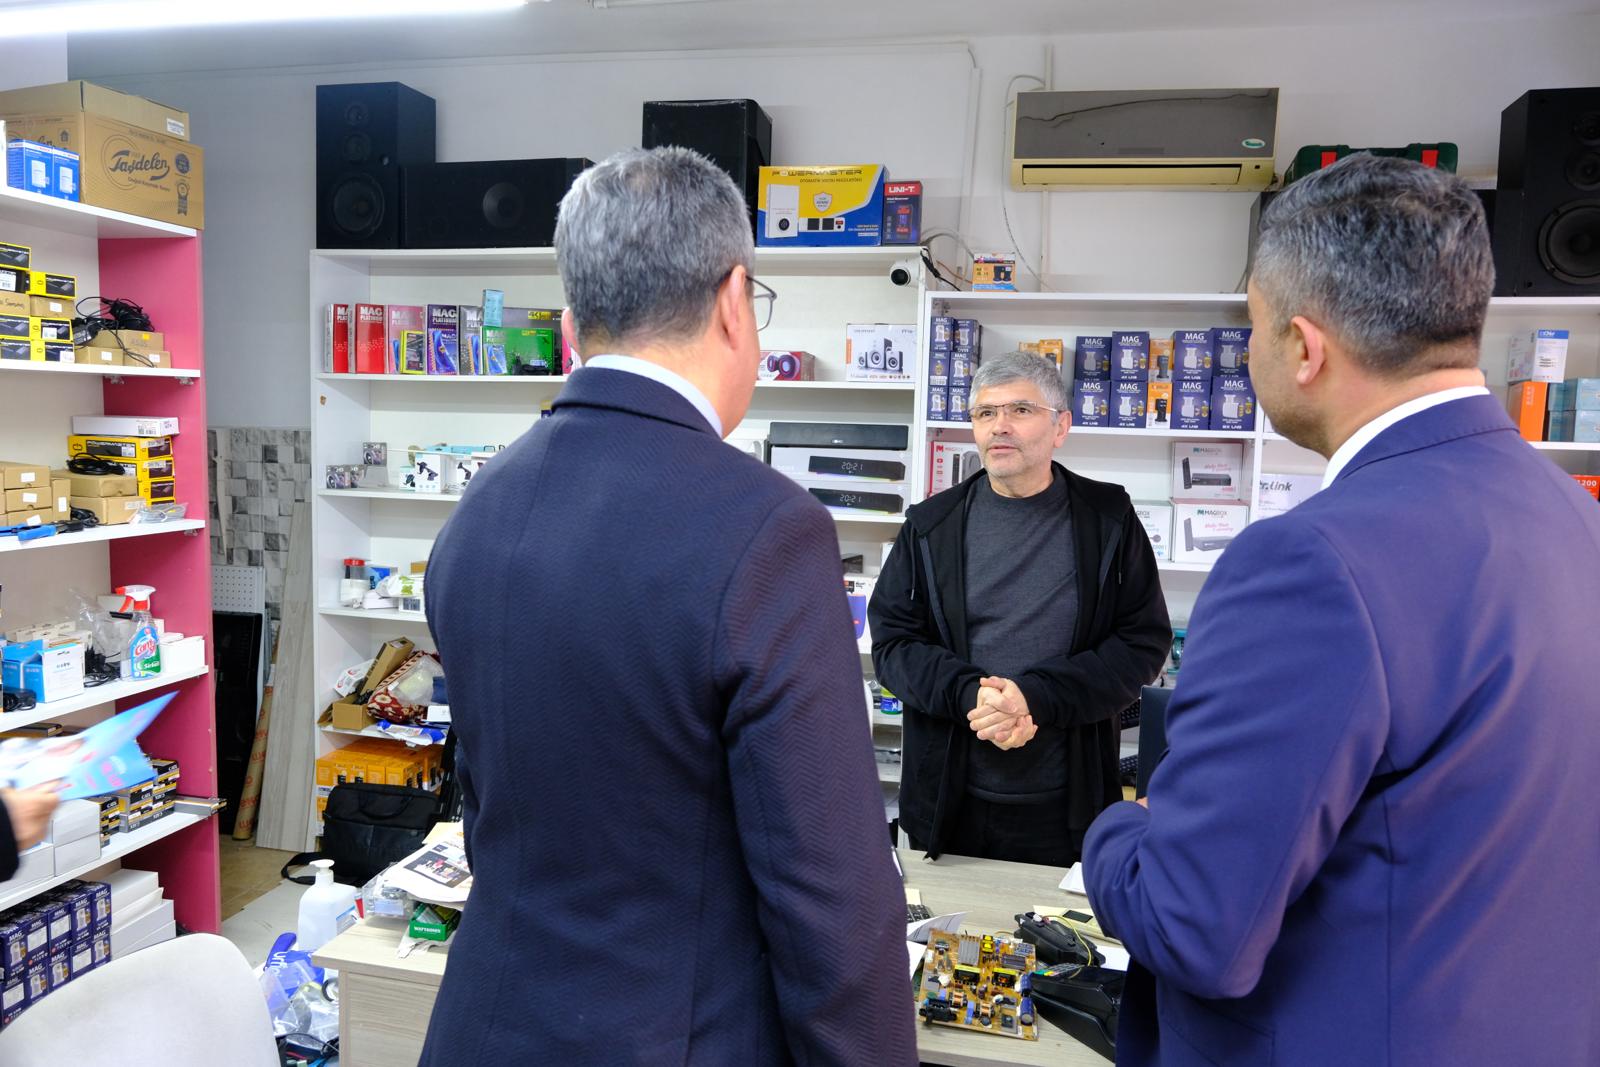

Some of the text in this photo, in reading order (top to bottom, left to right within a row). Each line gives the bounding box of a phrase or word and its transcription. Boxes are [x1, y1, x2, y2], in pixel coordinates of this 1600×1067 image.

[888, 185, 915, 193] UNI-T
[337, 306, 348, 316] MA
[432, 308, 456, 318] MAG
[466, 310, 483, 321] MA
[1121, 335, 1140, 343] MAG
[1224, 380, 1245, 388] MAG
[8, 930, 23, 941] MAG
[29, 963, 43, 975] MAG
